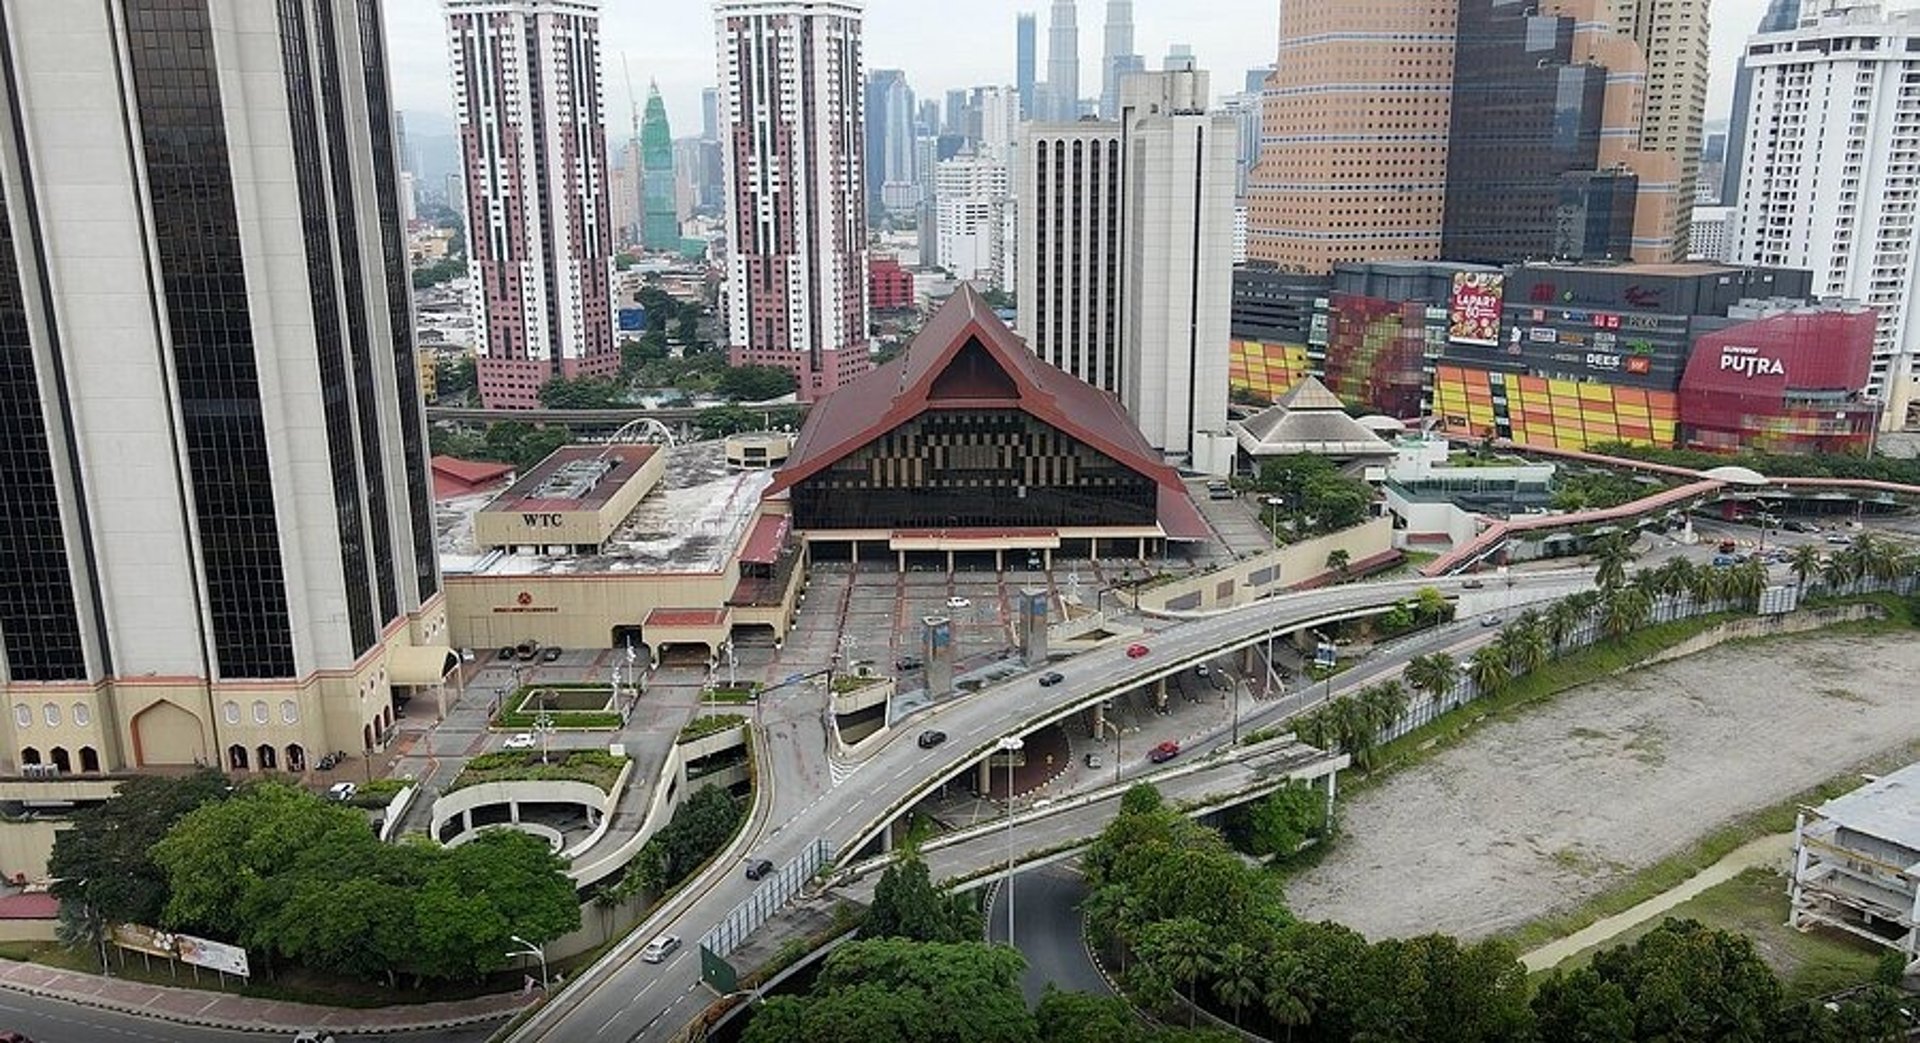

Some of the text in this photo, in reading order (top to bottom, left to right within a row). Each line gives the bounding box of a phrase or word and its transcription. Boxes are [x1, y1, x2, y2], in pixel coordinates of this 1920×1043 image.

[1457, 294, 1496, 308] LAPAR?
[1721, 355, 1784, 377] PUTRA
[522, 514, 562, 527] WTC
